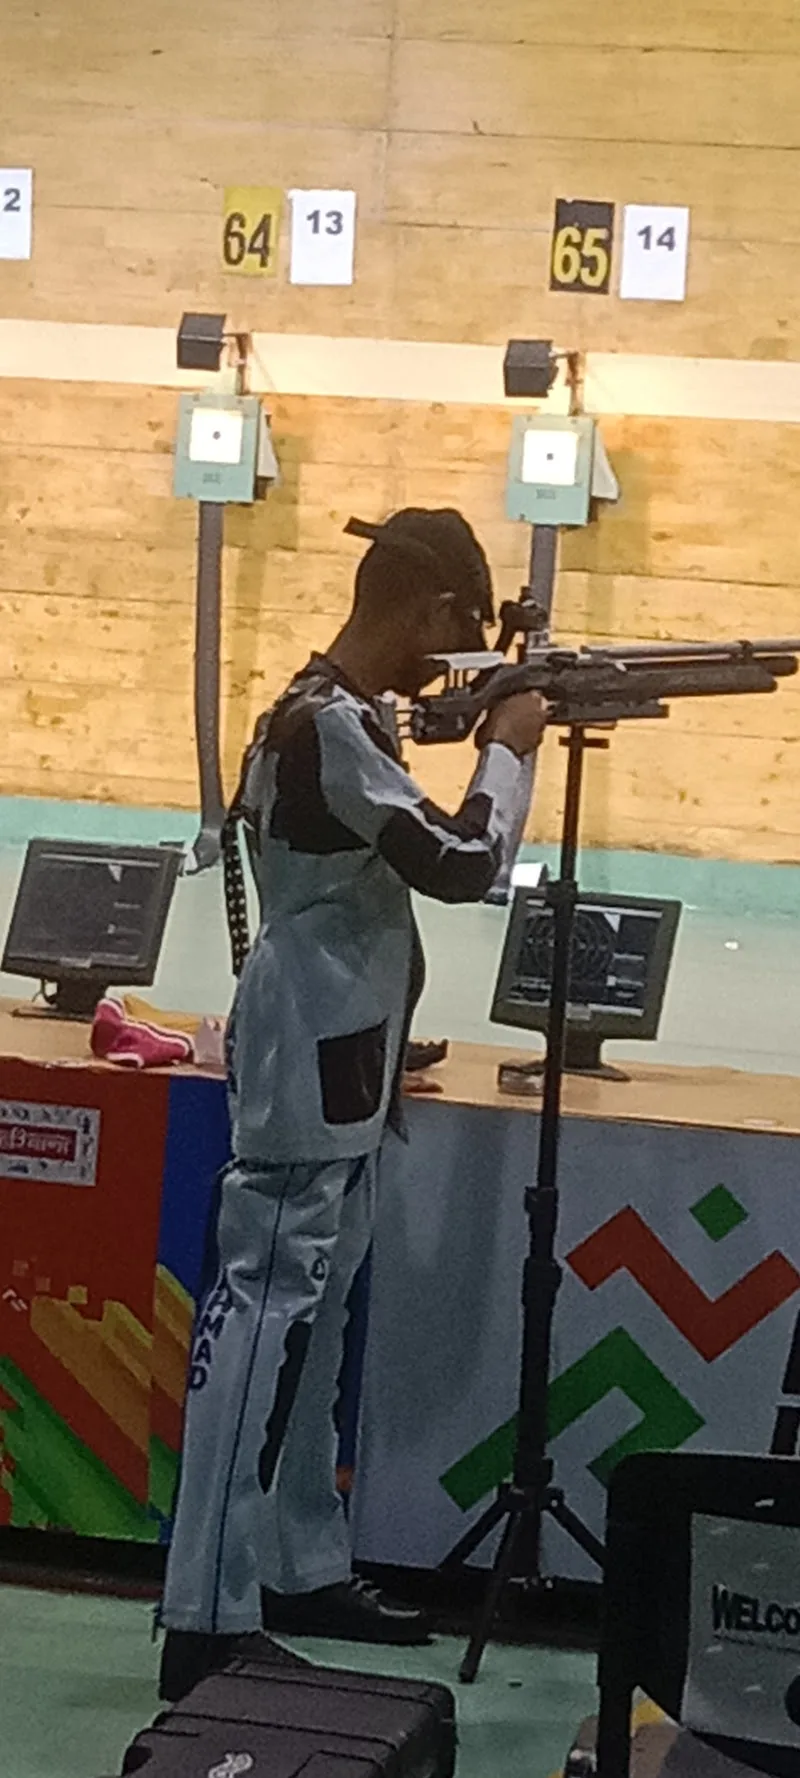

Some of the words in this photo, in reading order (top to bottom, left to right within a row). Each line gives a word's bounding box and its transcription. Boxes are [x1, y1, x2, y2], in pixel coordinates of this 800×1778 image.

[223, 212, 272, 268] 64
[306, 210, 344, 235] 13
[637, 225, 676, 252] 14
[552, 226, 609, 287] 65
